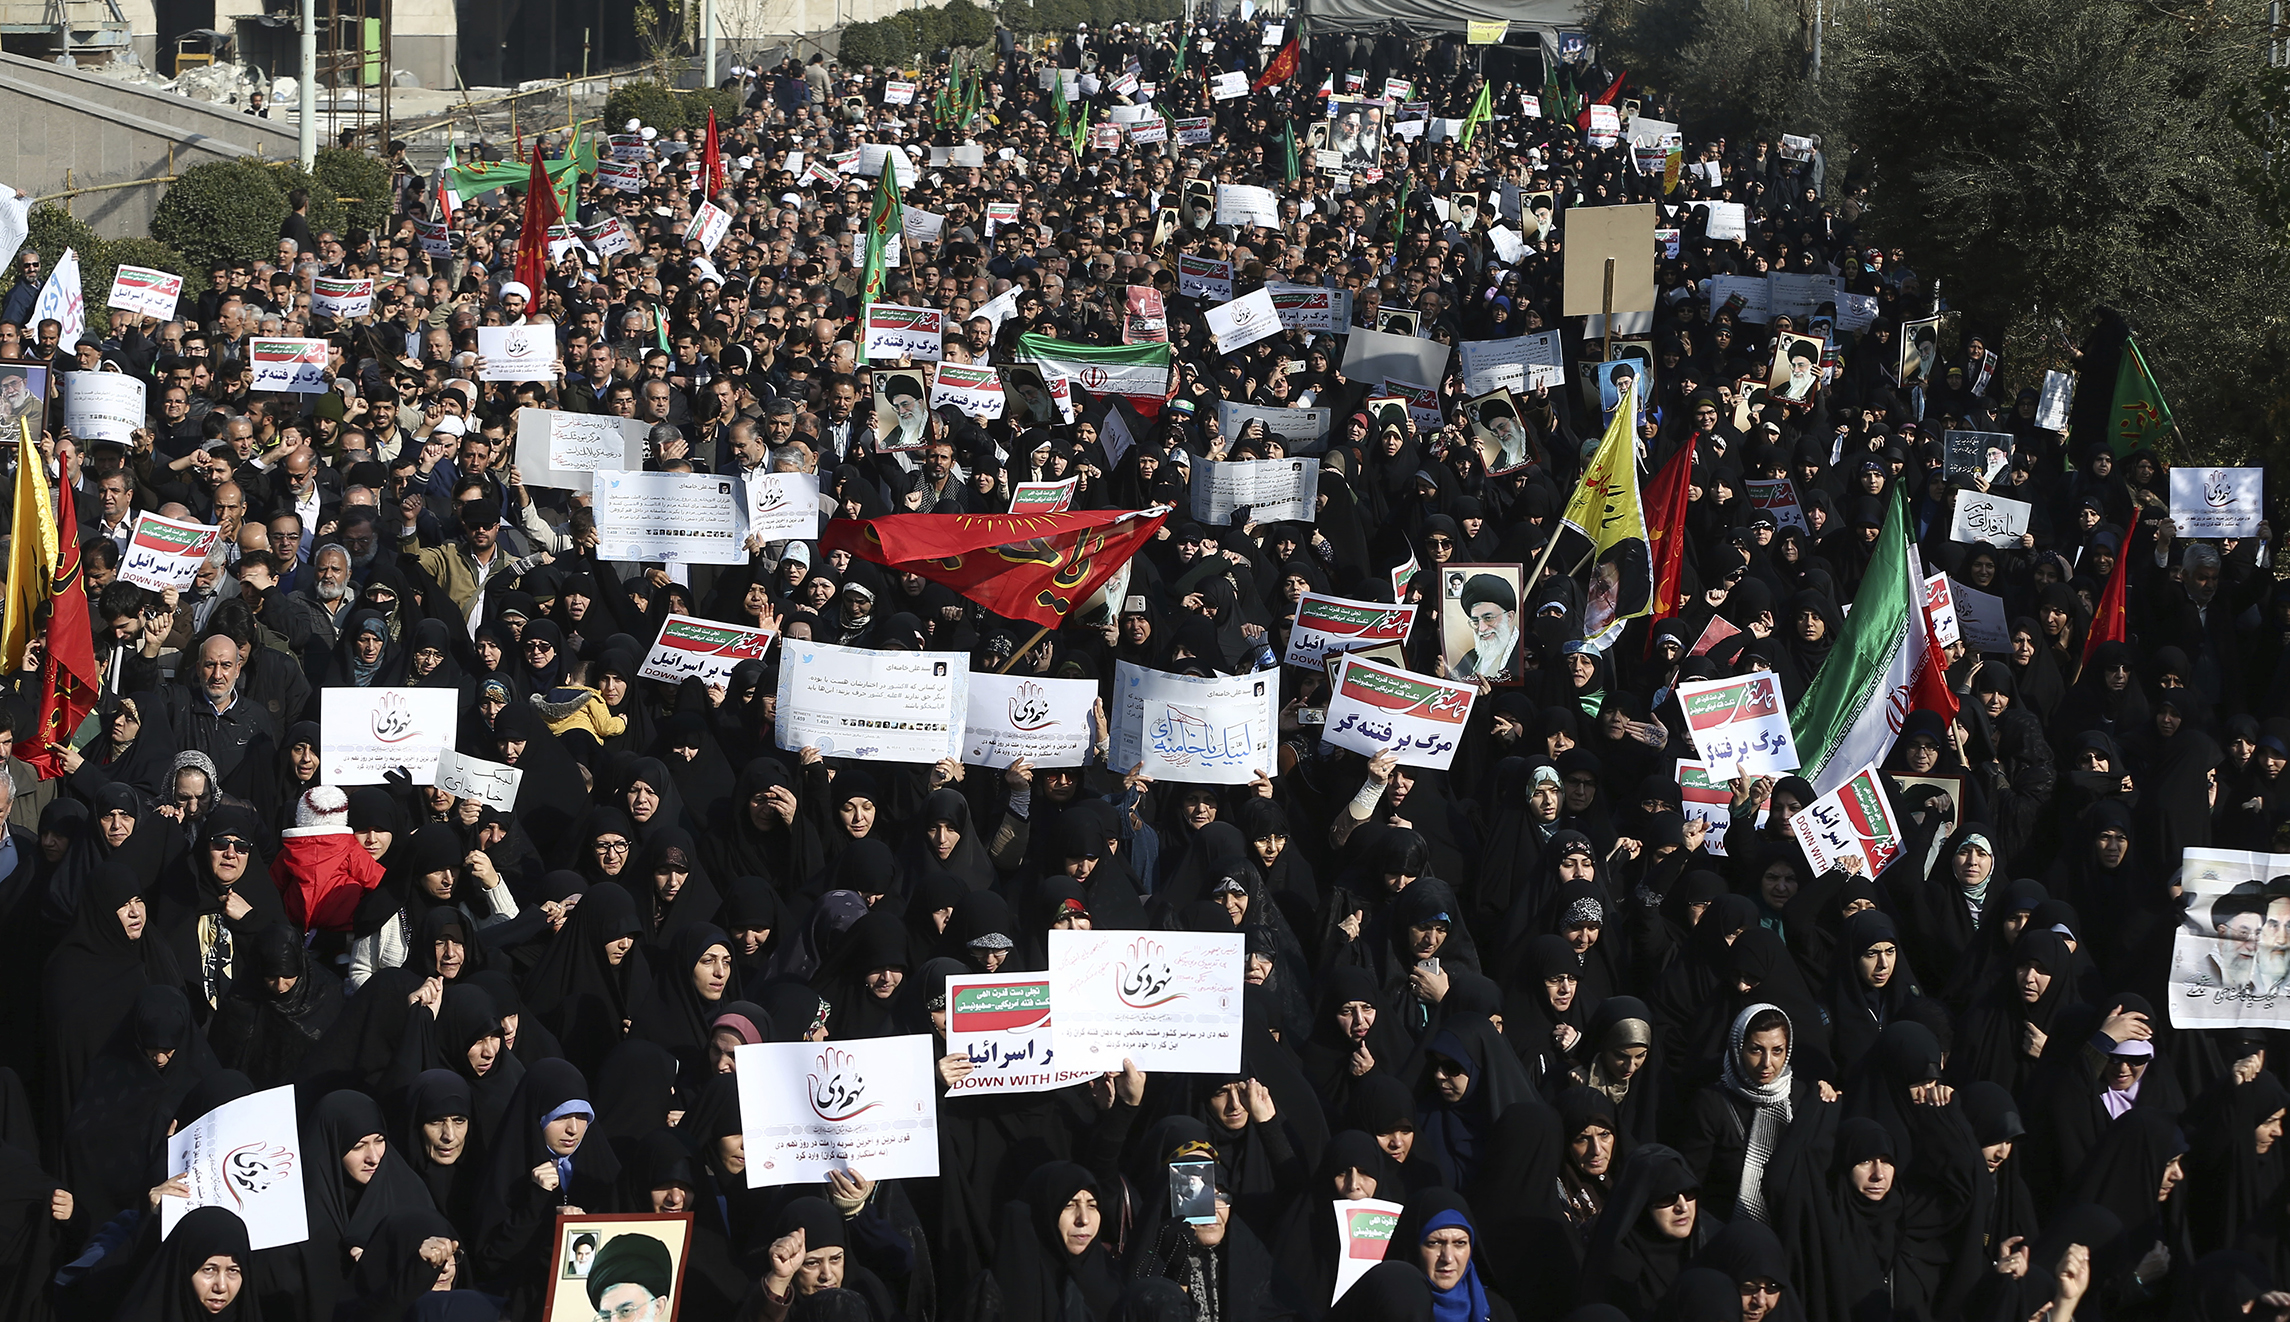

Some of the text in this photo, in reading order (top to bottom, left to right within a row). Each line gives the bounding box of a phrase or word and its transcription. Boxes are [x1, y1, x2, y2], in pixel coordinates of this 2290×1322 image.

[123, 572, 152, 585] DOWN
[644, 668, 678, 681] DOWN
[1796, 815, 1828, 872] DOWN WITH
[976, 987, 1040, 1000] تجلی دست قدرت الهی
[953, 1074, 1050, 1089] DOWN WITH
